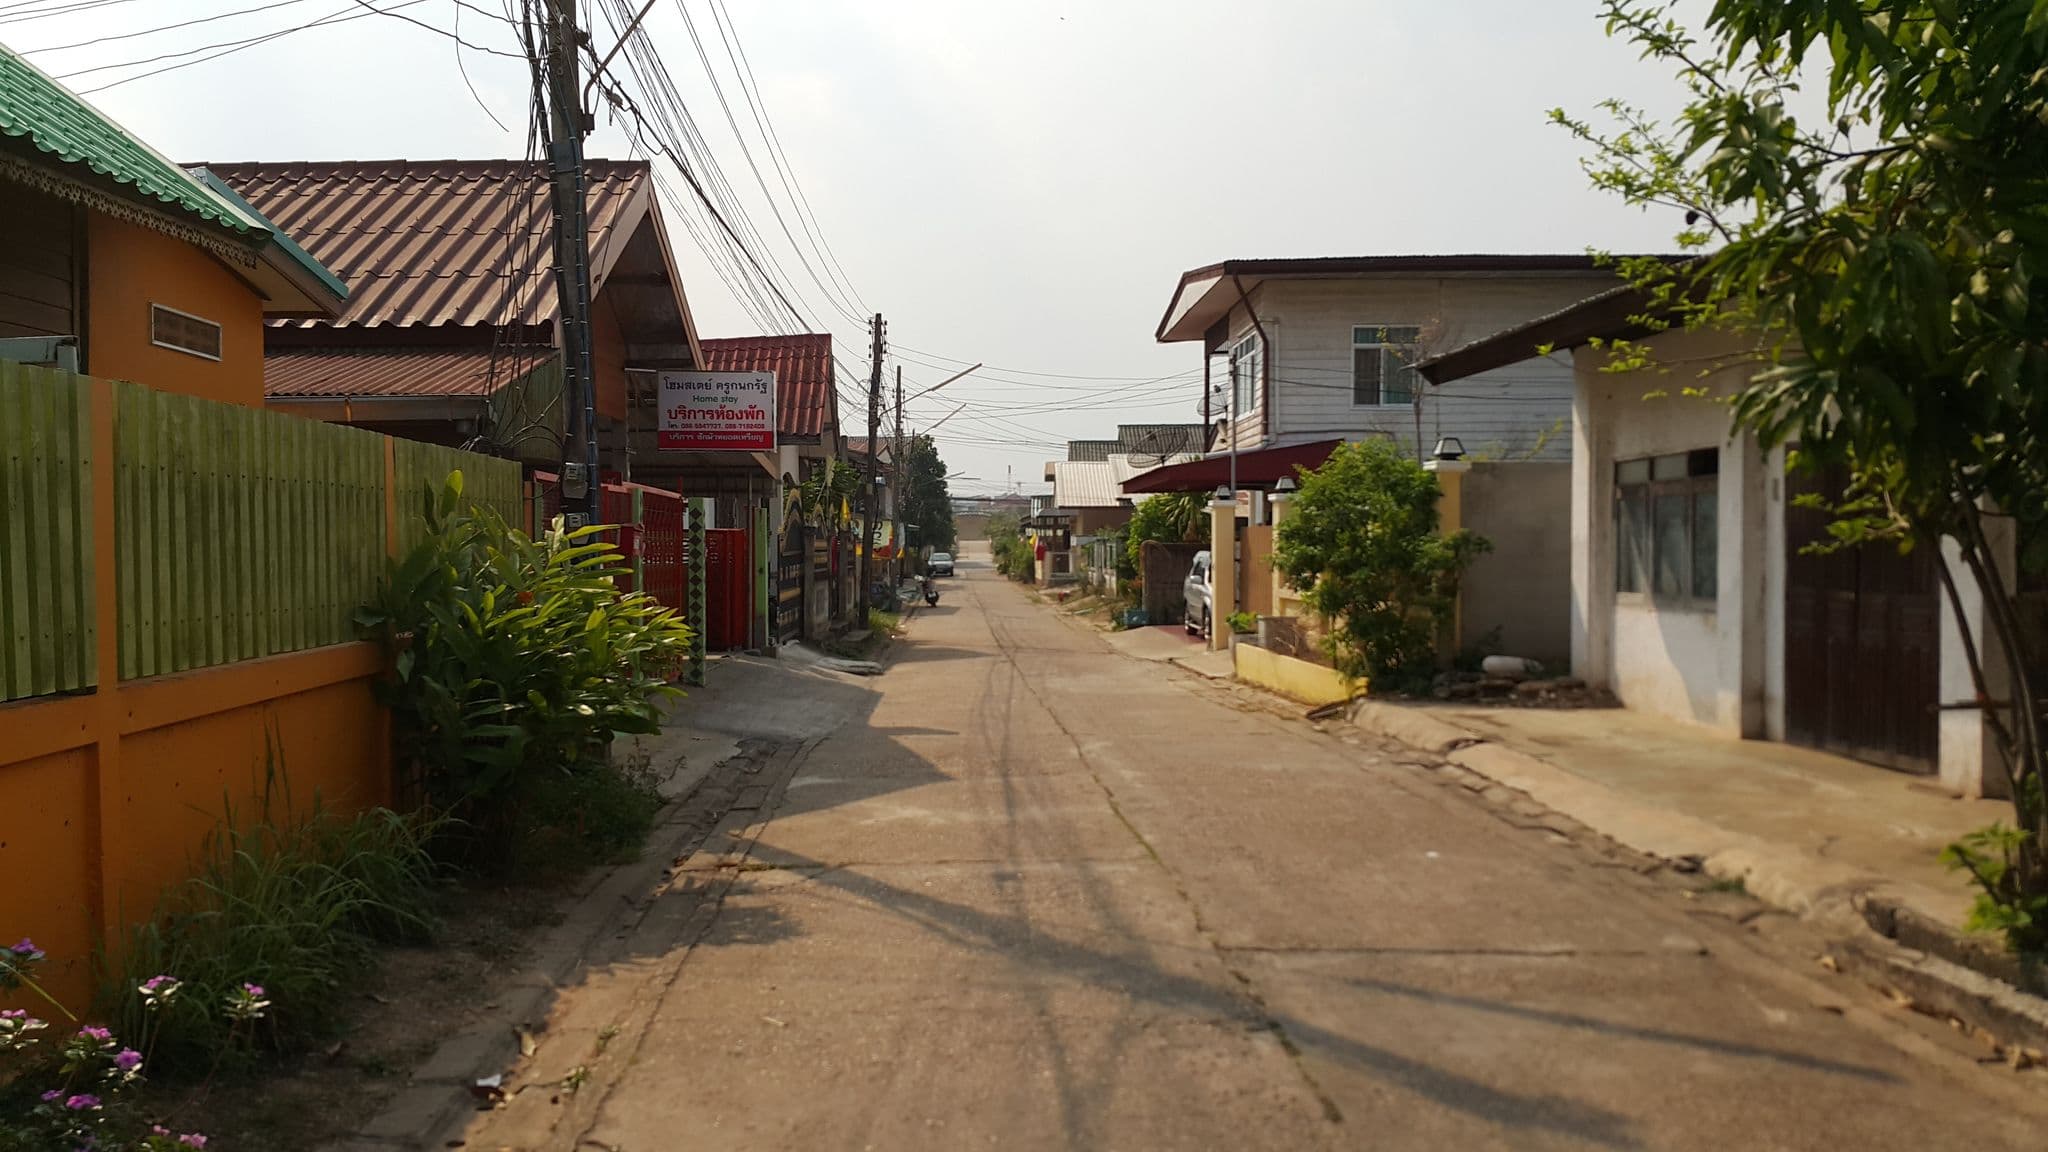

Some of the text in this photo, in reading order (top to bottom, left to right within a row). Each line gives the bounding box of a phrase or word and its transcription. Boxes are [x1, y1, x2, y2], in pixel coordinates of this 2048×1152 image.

[664, 376, 712, 391] โฮมสเตย์
[692, 395, 738, 404] Home stay
[667, 404, 765, 420] บริการห้องพัก
